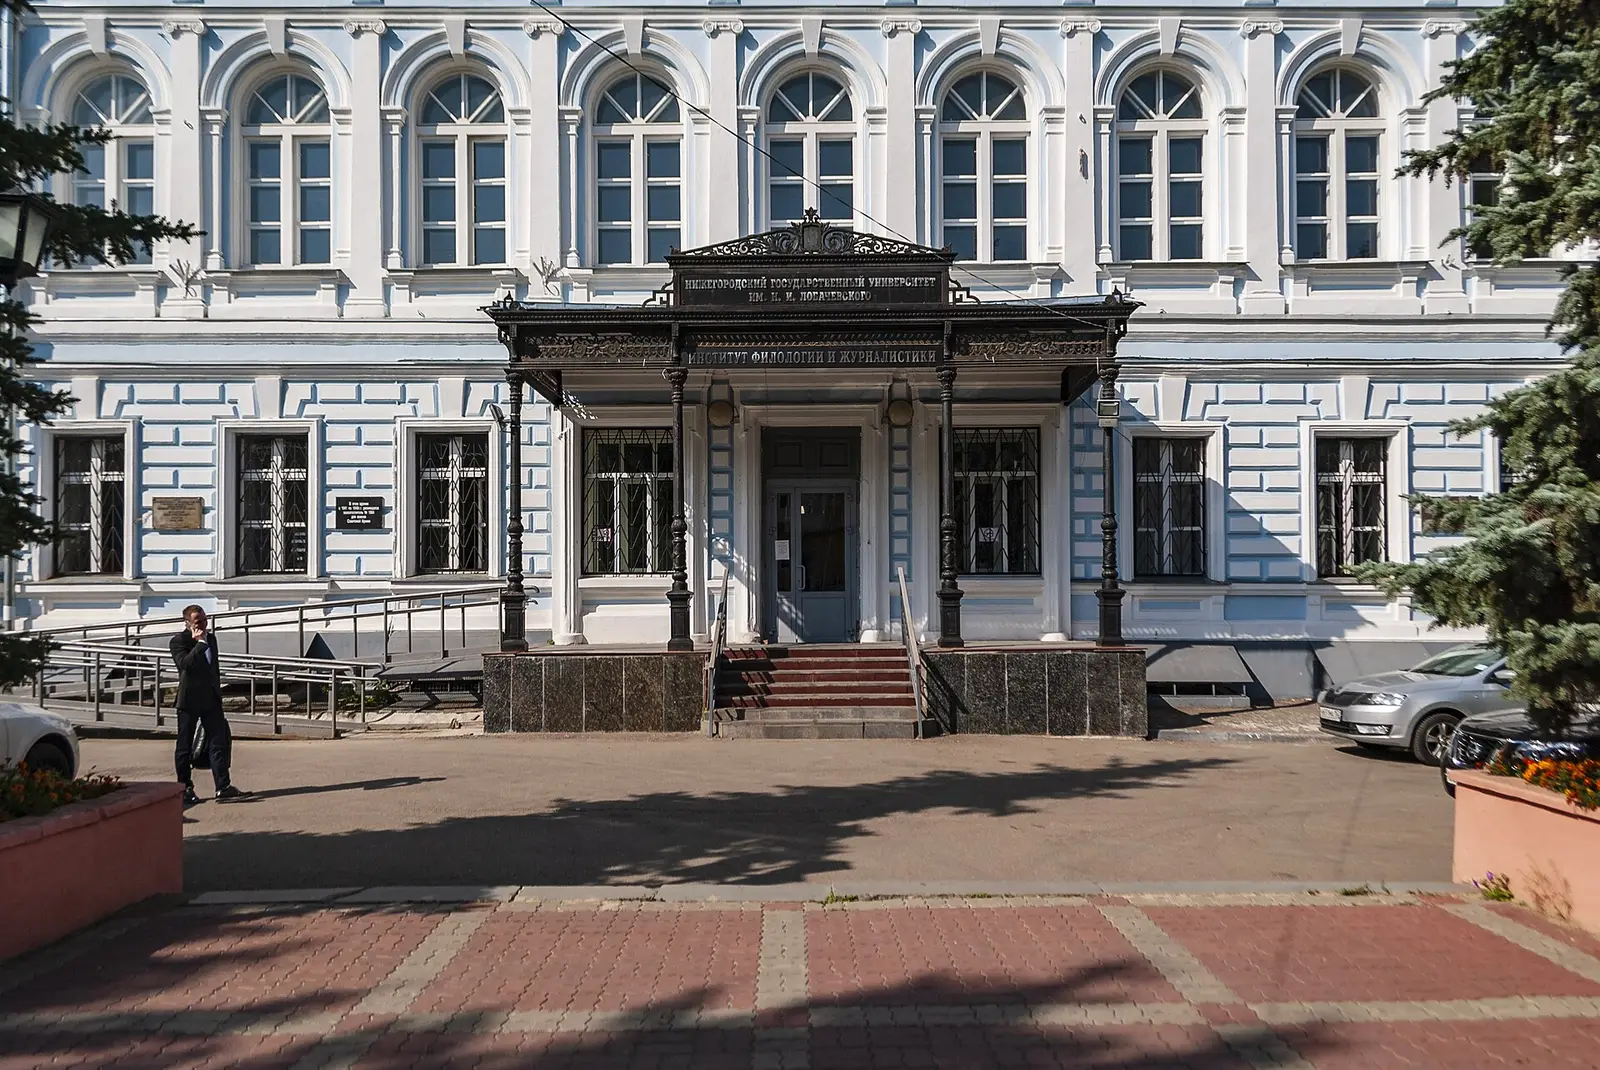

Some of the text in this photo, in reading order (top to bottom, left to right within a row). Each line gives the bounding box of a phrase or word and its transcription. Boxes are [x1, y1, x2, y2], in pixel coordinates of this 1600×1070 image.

[684, 275, 936, 290] НИЖЕГОРОДСКИЙ ГОСУДАРСТВЕННЫЙ УНИВЕРСИТЕТ
[748, 291, 872, 302] ИМ. Н. И. ЛОБАЧЕВСКОГО
[688, 350, 937, 365] ИНСТИТУТ ФИЛОЛОГИИ И ЖУРНАЛИСТИКИ
